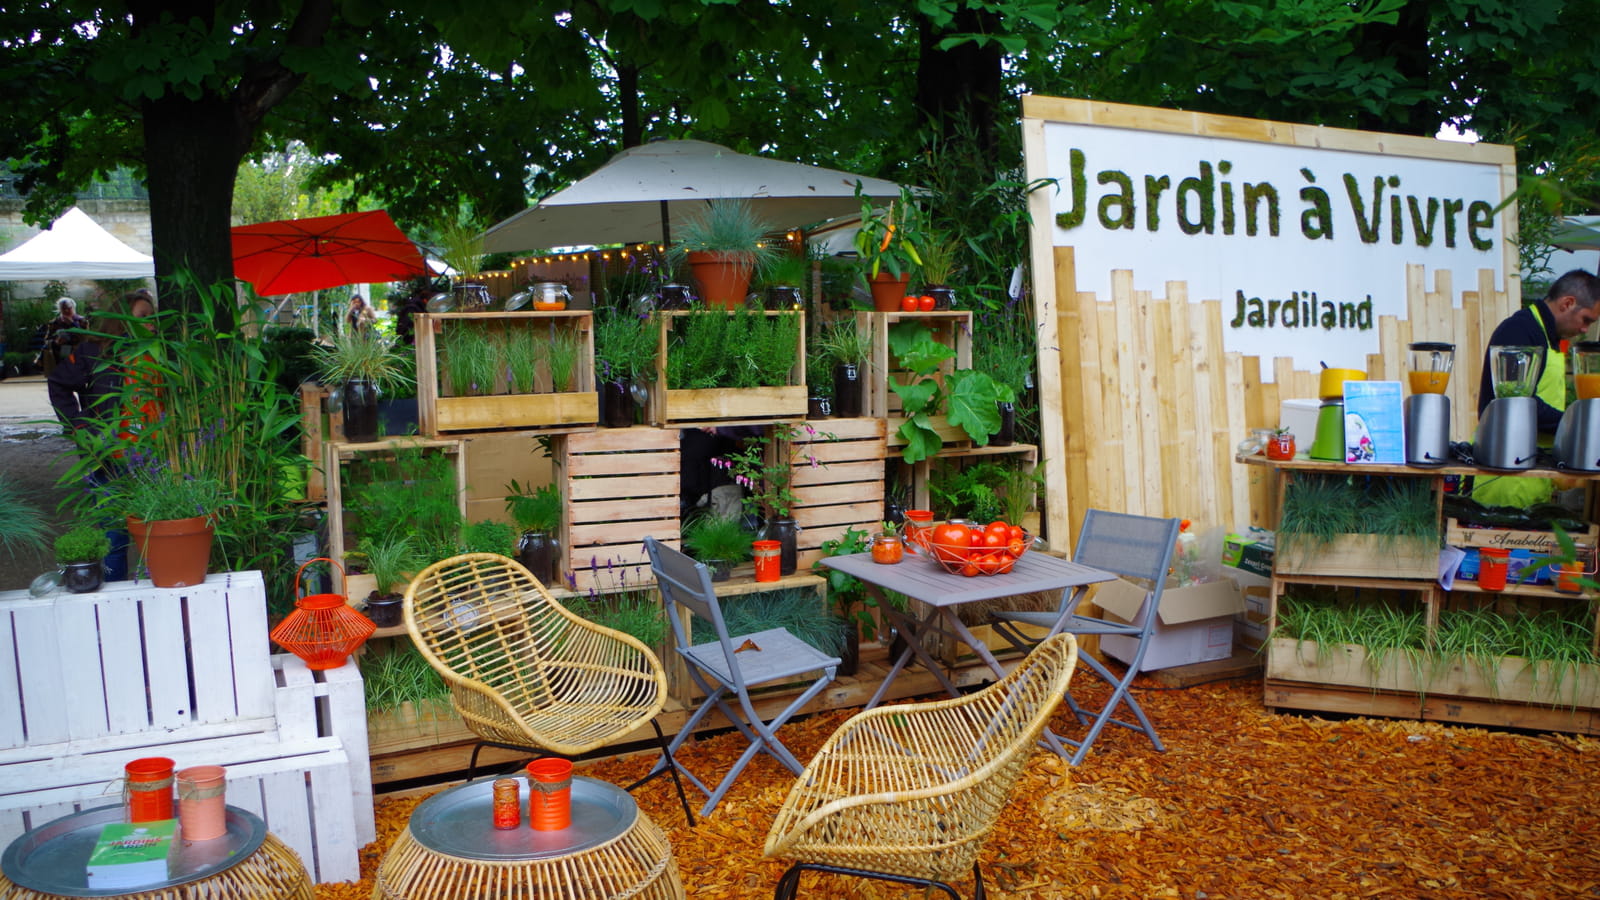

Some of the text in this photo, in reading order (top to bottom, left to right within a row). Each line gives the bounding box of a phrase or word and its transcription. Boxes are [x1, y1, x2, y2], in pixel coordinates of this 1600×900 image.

[1055, 148, 1495, 251] Jardin à Vivre
[1230, 289, 1373, 331] Jardiland
